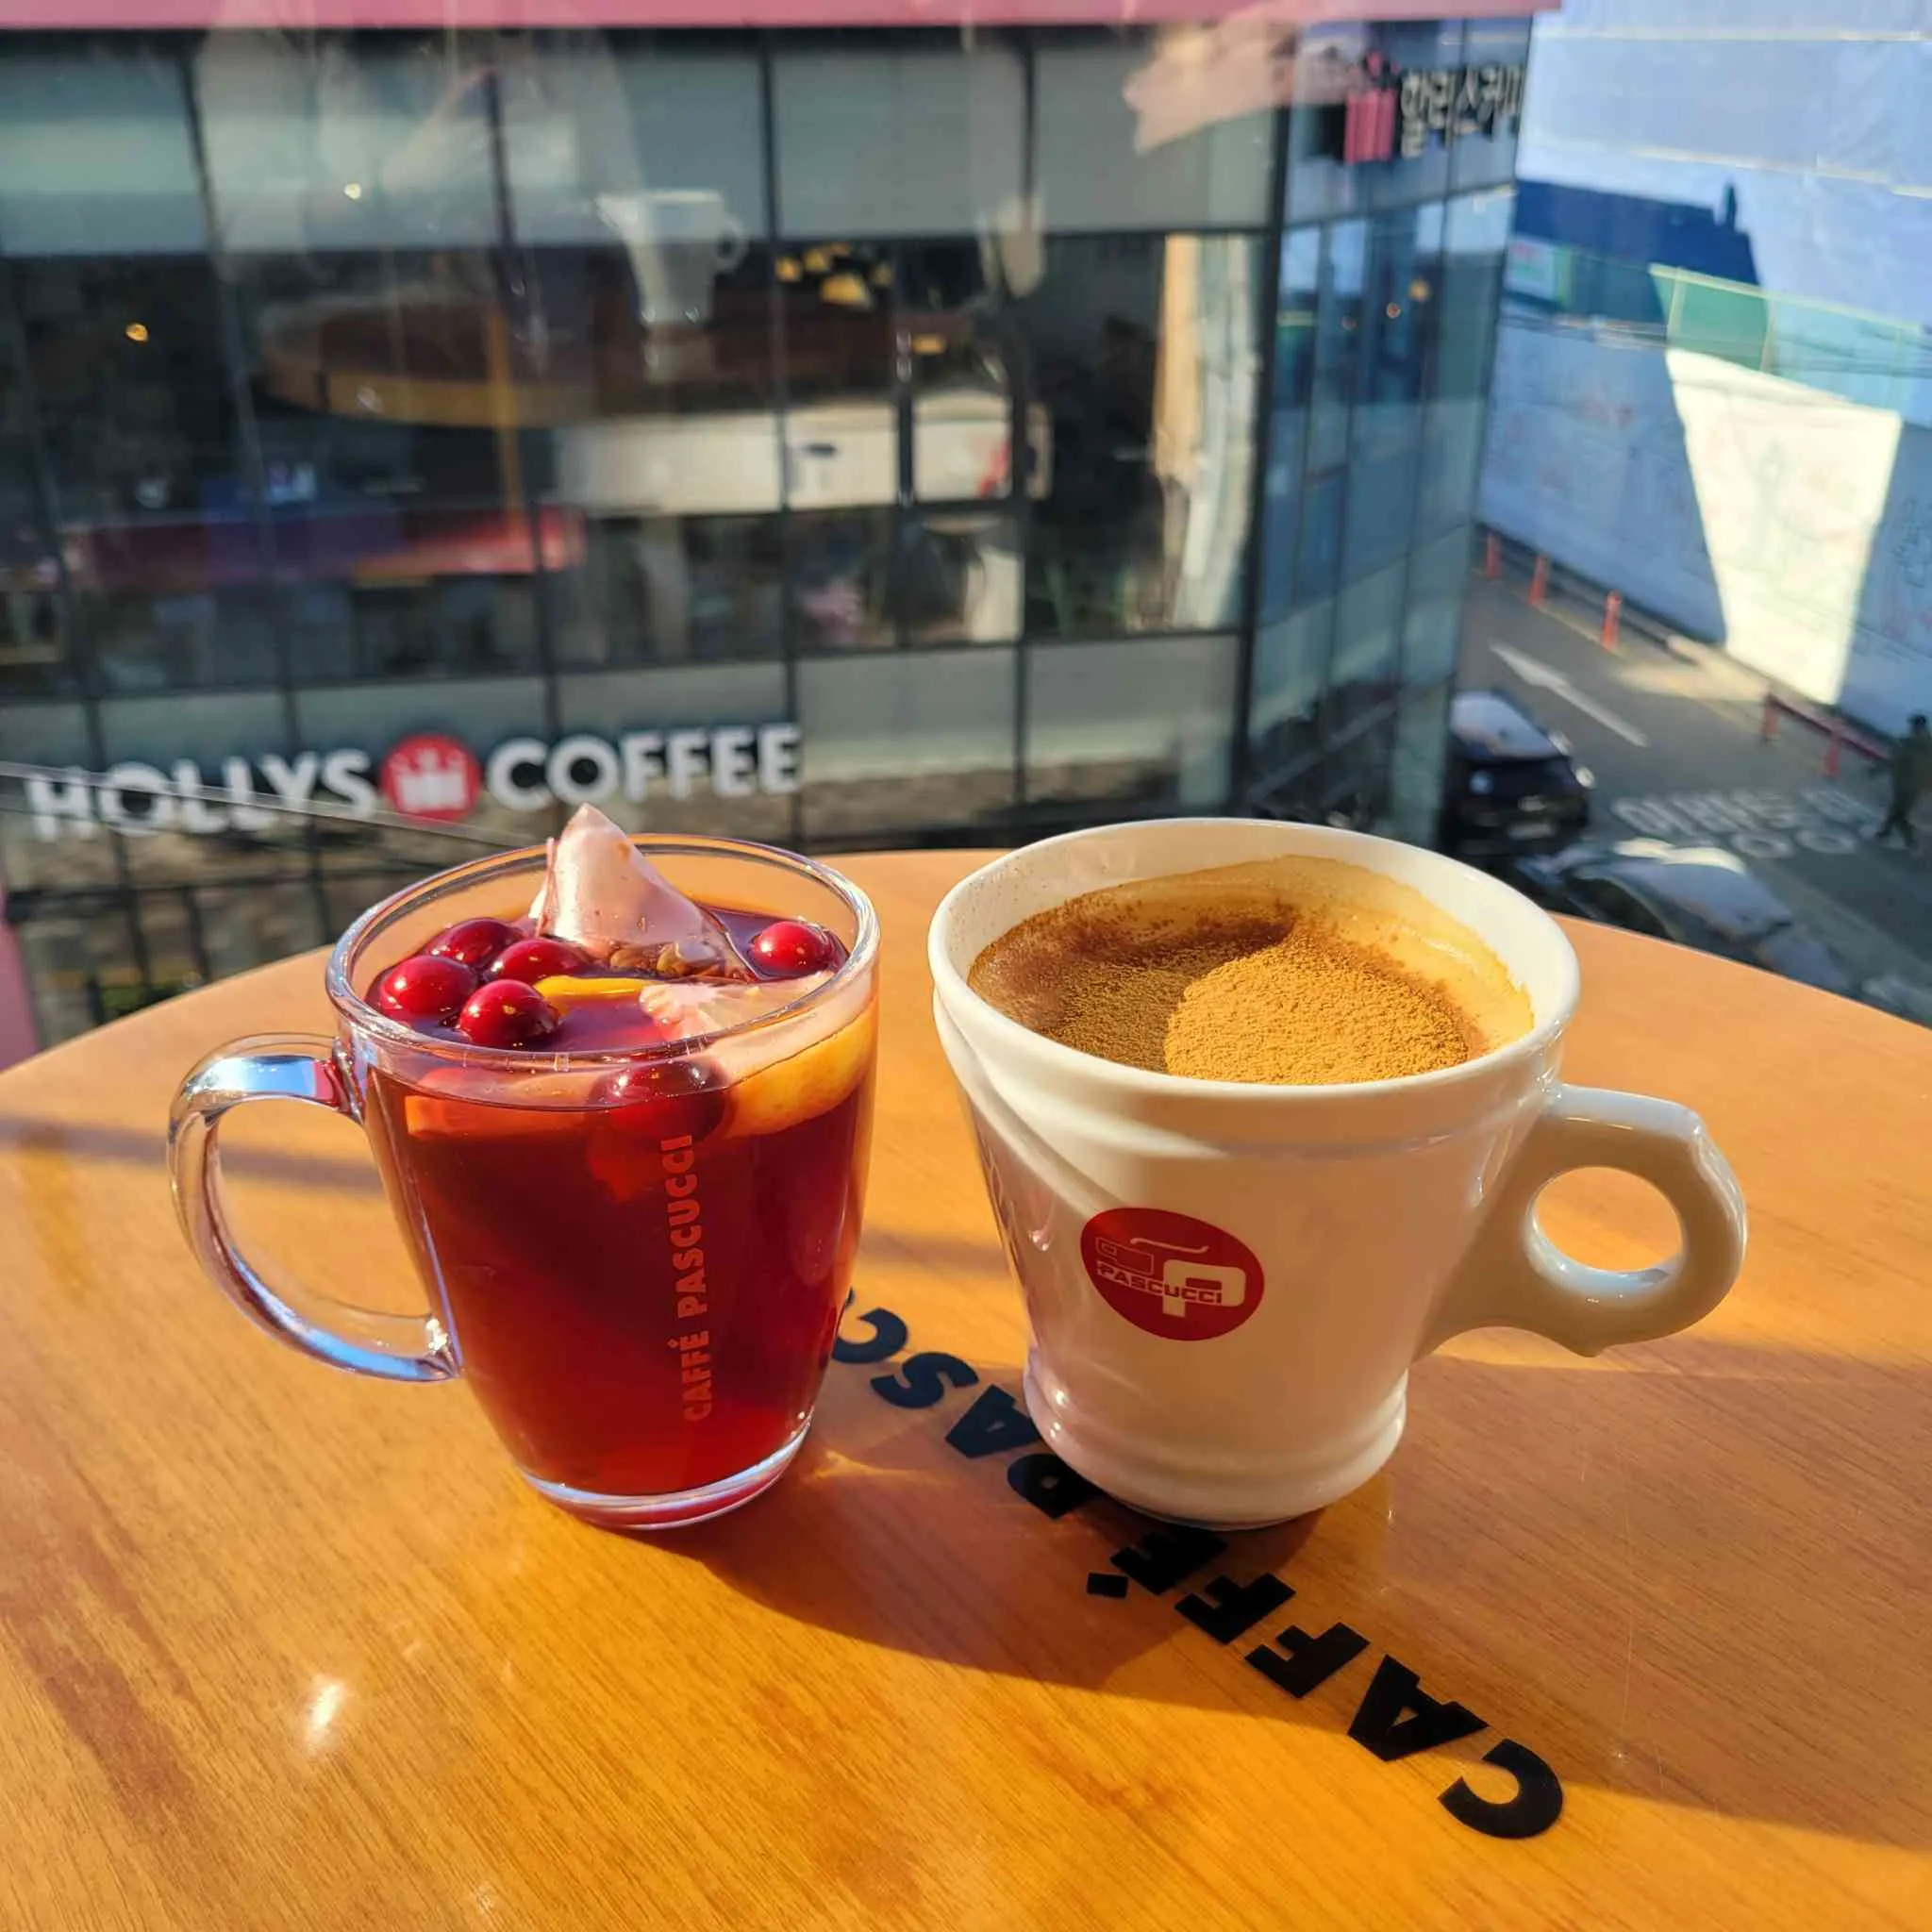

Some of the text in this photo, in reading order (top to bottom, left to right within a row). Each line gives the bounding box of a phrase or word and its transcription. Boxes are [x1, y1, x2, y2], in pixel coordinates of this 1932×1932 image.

[25, 724, 803, 841] HOLLYS COFFEE
[659, 1134, 709, 1318] PASCUCCI
[1096, 1260, 1223, 1305] PASCUCCI
